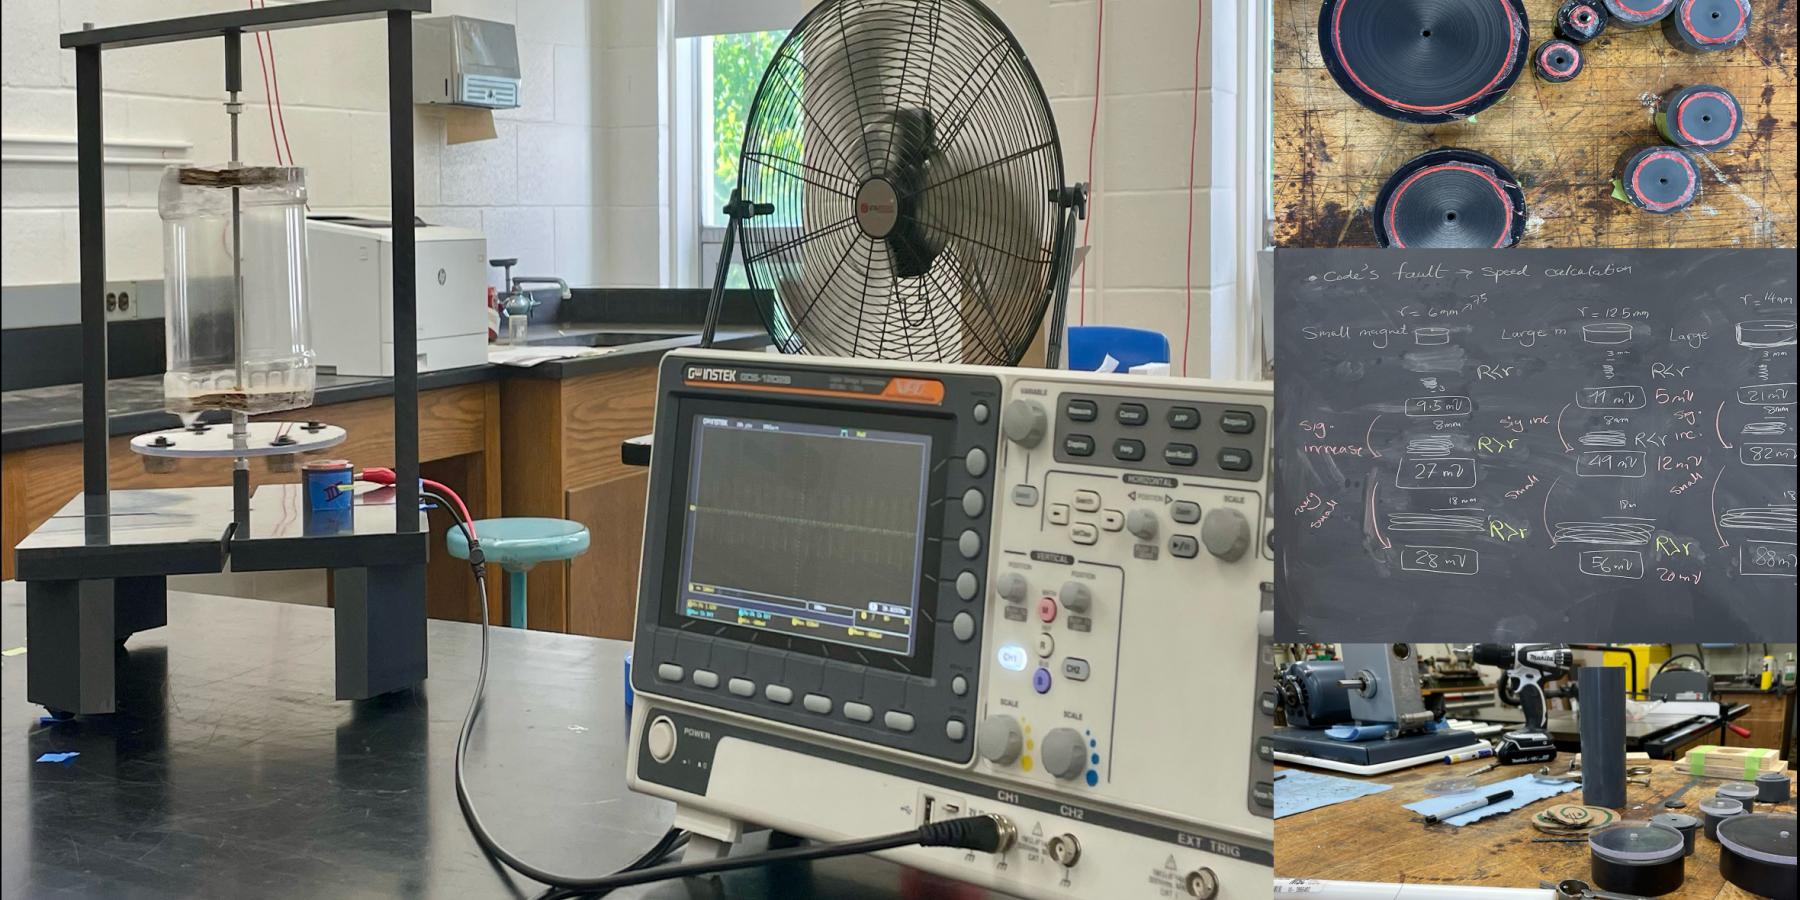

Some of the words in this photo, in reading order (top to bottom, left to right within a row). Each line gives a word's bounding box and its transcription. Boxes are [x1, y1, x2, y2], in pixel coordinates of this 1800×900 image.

[1322, 263, 1380, 282] Code's
[1392, 261, 1449, 281] fault
[1544, 263, 1633, 278] calculation
[1359, 323, 1409, 349] magnet
[1501, 328, 1548, 348] Large
[1669, 327, 1710, 349] Large
[1303, 443, 1363, 458] increase
[1223, 494, 1246, 505] SCALE
[1039, 640, 1046, 650] R
[1002, 652, 1017, 664] CH1
[1065, 663, 1081, 675] CH2
[1000, 697, 1019, 709] SCALE
[1063, 709, 1084, 721] SCALE
[683, 726, 711, 740] POWER
[997, 789, 1020, 804] CH1
[1060, 804, 1085, 820] CH2
[1177, 832, 1204, 849] EXT
[1209, 839, 1241, 858] TRIG
